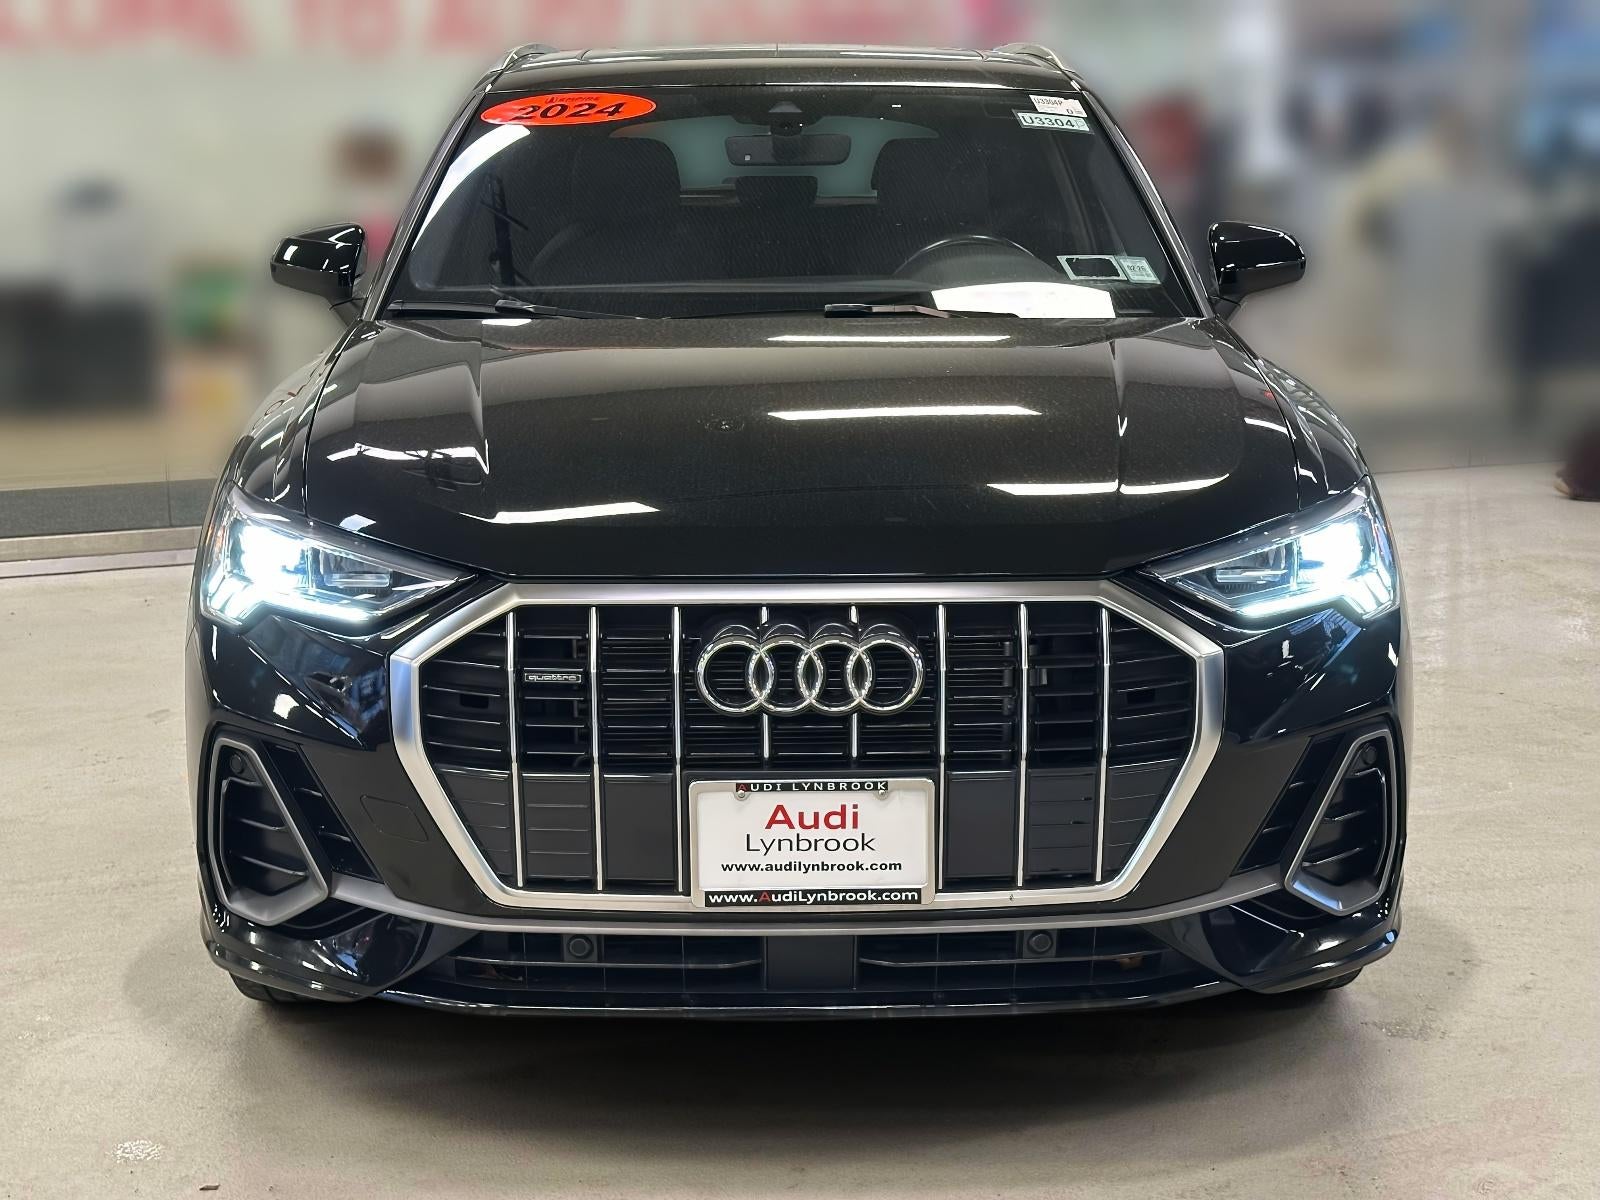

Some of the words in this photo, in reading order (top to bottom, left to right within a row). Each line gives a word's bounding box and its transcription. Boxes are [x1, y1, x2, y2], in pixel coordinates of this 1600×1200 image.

[509, 102, 627, 121] 2024
[528, 674, 577, 682] quattro
[736, 782, 783, 792] AUDI
[792, 781, 889, 791] LYNBROOK
[765, 803, 859, 830] Audi
[746, 833, 876, 856] Lynbrook
[721, 860, 902, 874] www.audilynbrook.com
[708, 890, 919, 905] www.AudiLynbrook.com
